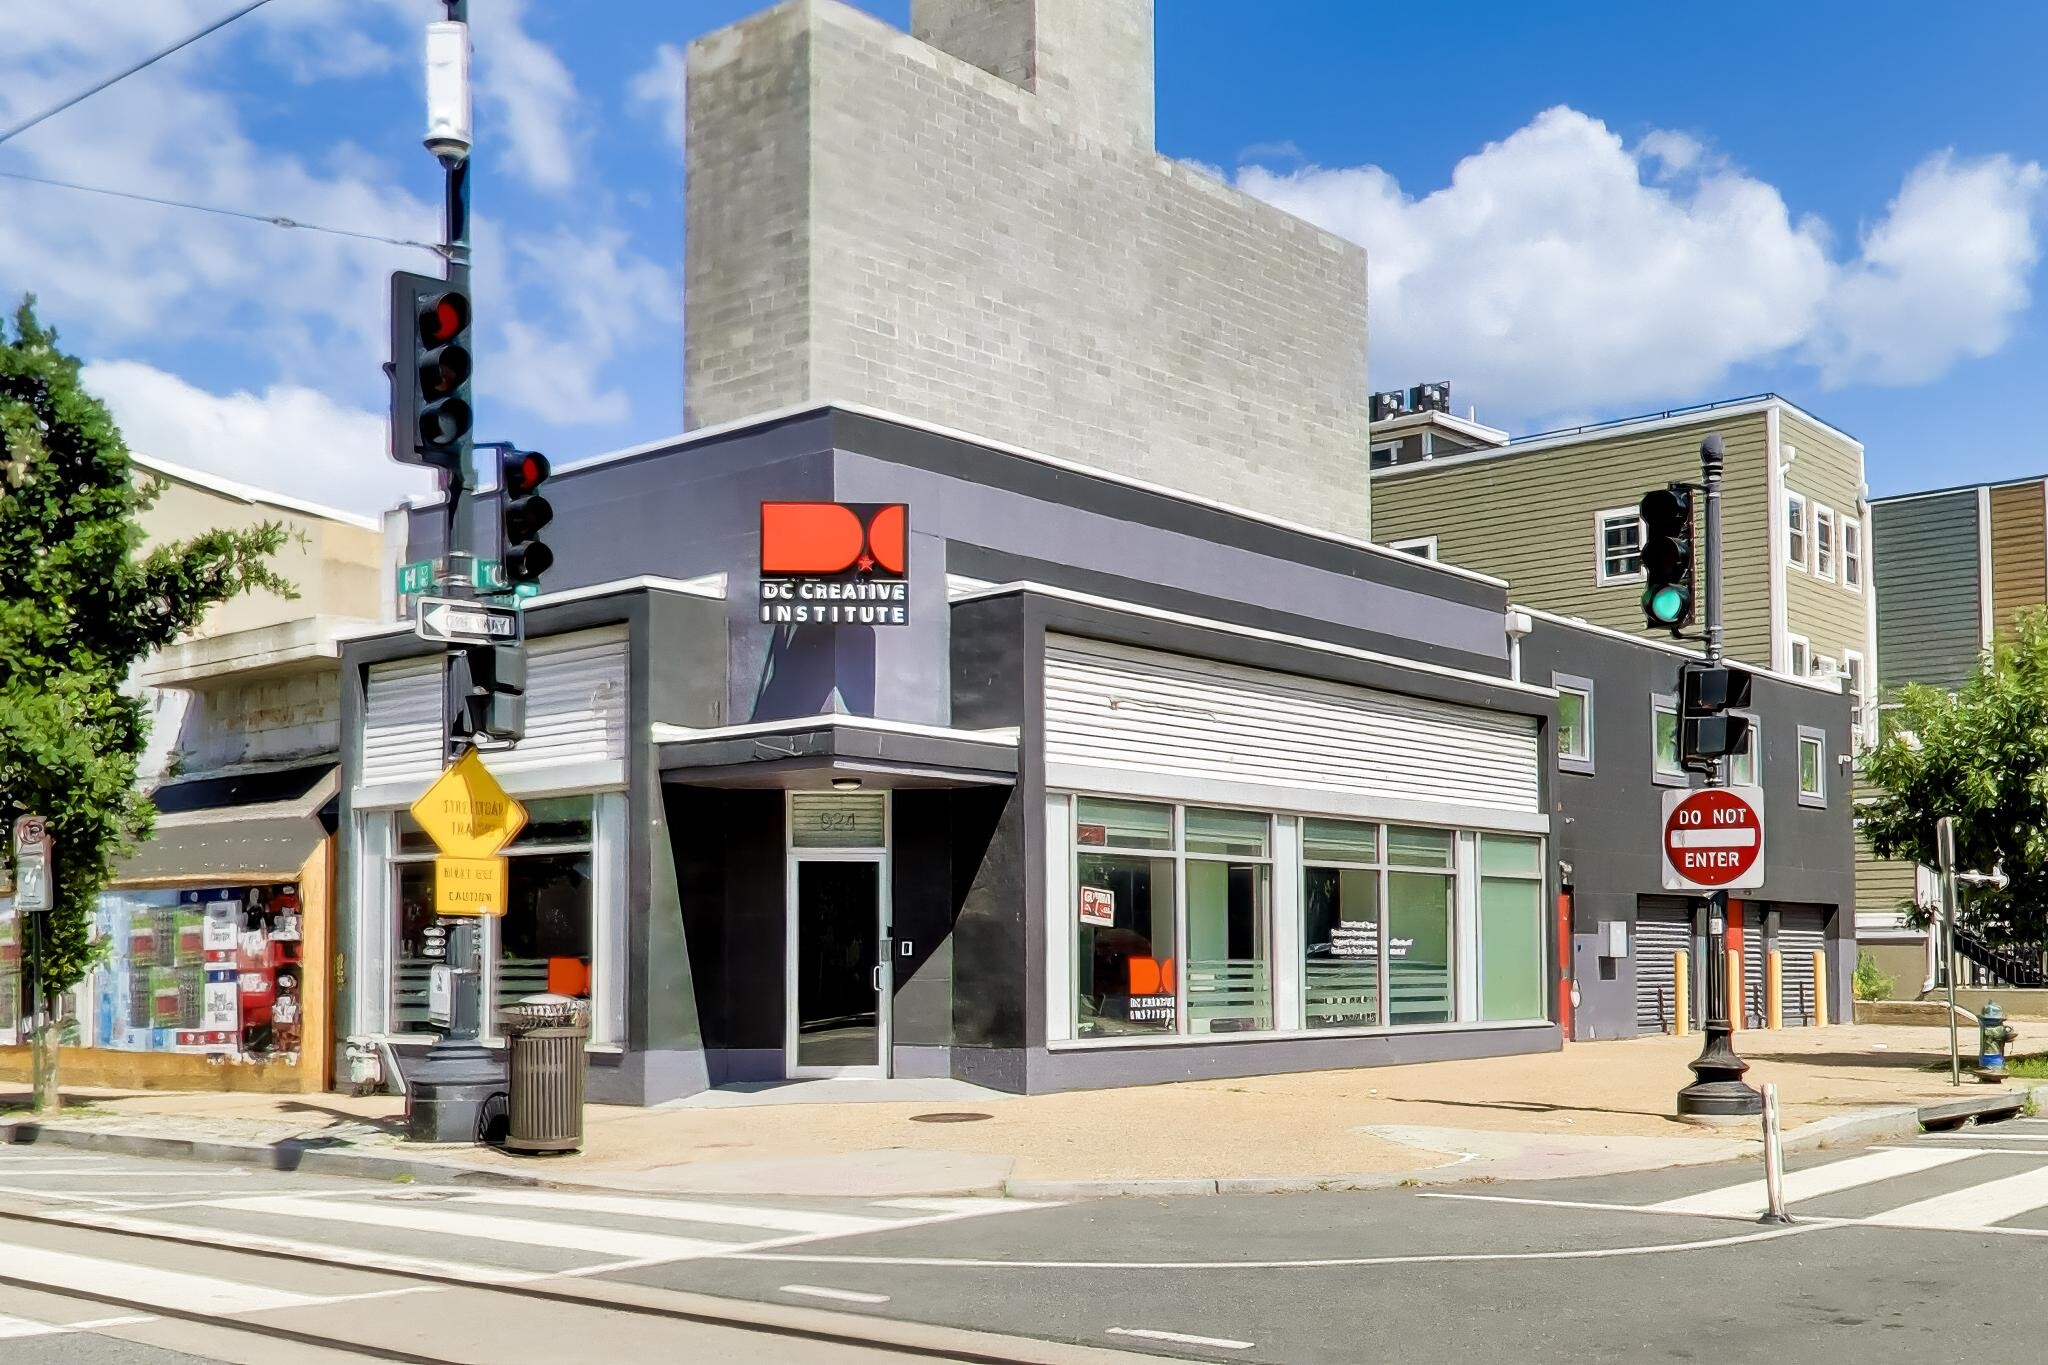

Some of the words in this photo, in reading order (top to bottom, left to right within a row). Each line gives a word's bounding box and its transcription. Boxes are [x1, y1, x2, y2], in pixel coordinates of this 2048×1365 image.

[763, 583, 795, 600] DC
[800, 583, 905, 600] CREATIVE
[763, 605, 905, 623] INSTITUTE
[1679, 809, 1702, 825] DO
[1713, 808, 1747, 824] NOT
[1685, 851, 1740, 868] ENTER
